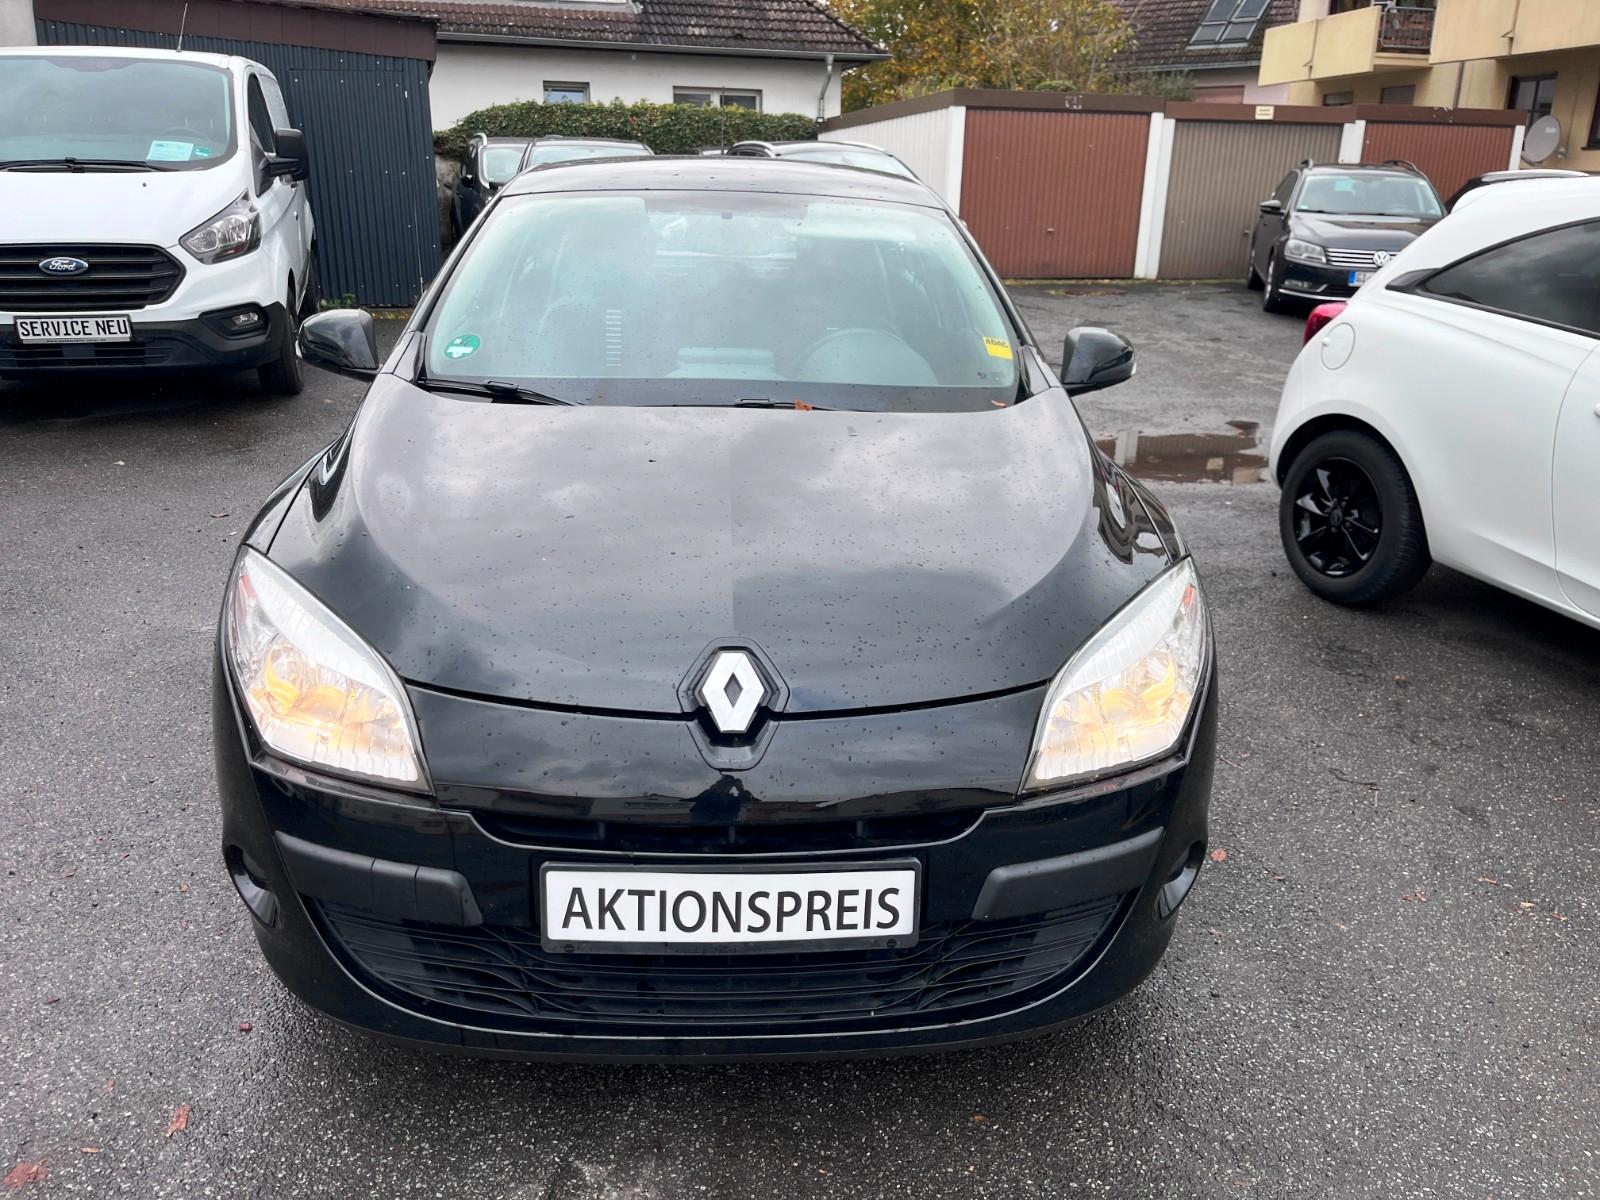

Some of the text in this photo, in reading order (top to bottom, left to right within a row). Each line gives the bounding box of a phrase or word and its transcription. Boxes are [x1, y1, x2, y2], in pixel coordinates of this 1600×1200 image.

[49, 259, 76, 270] Ford
[19, 319, 129, 337] SERVICE NEU
[561, 886, 901, 934] AKTIONSPREIS
